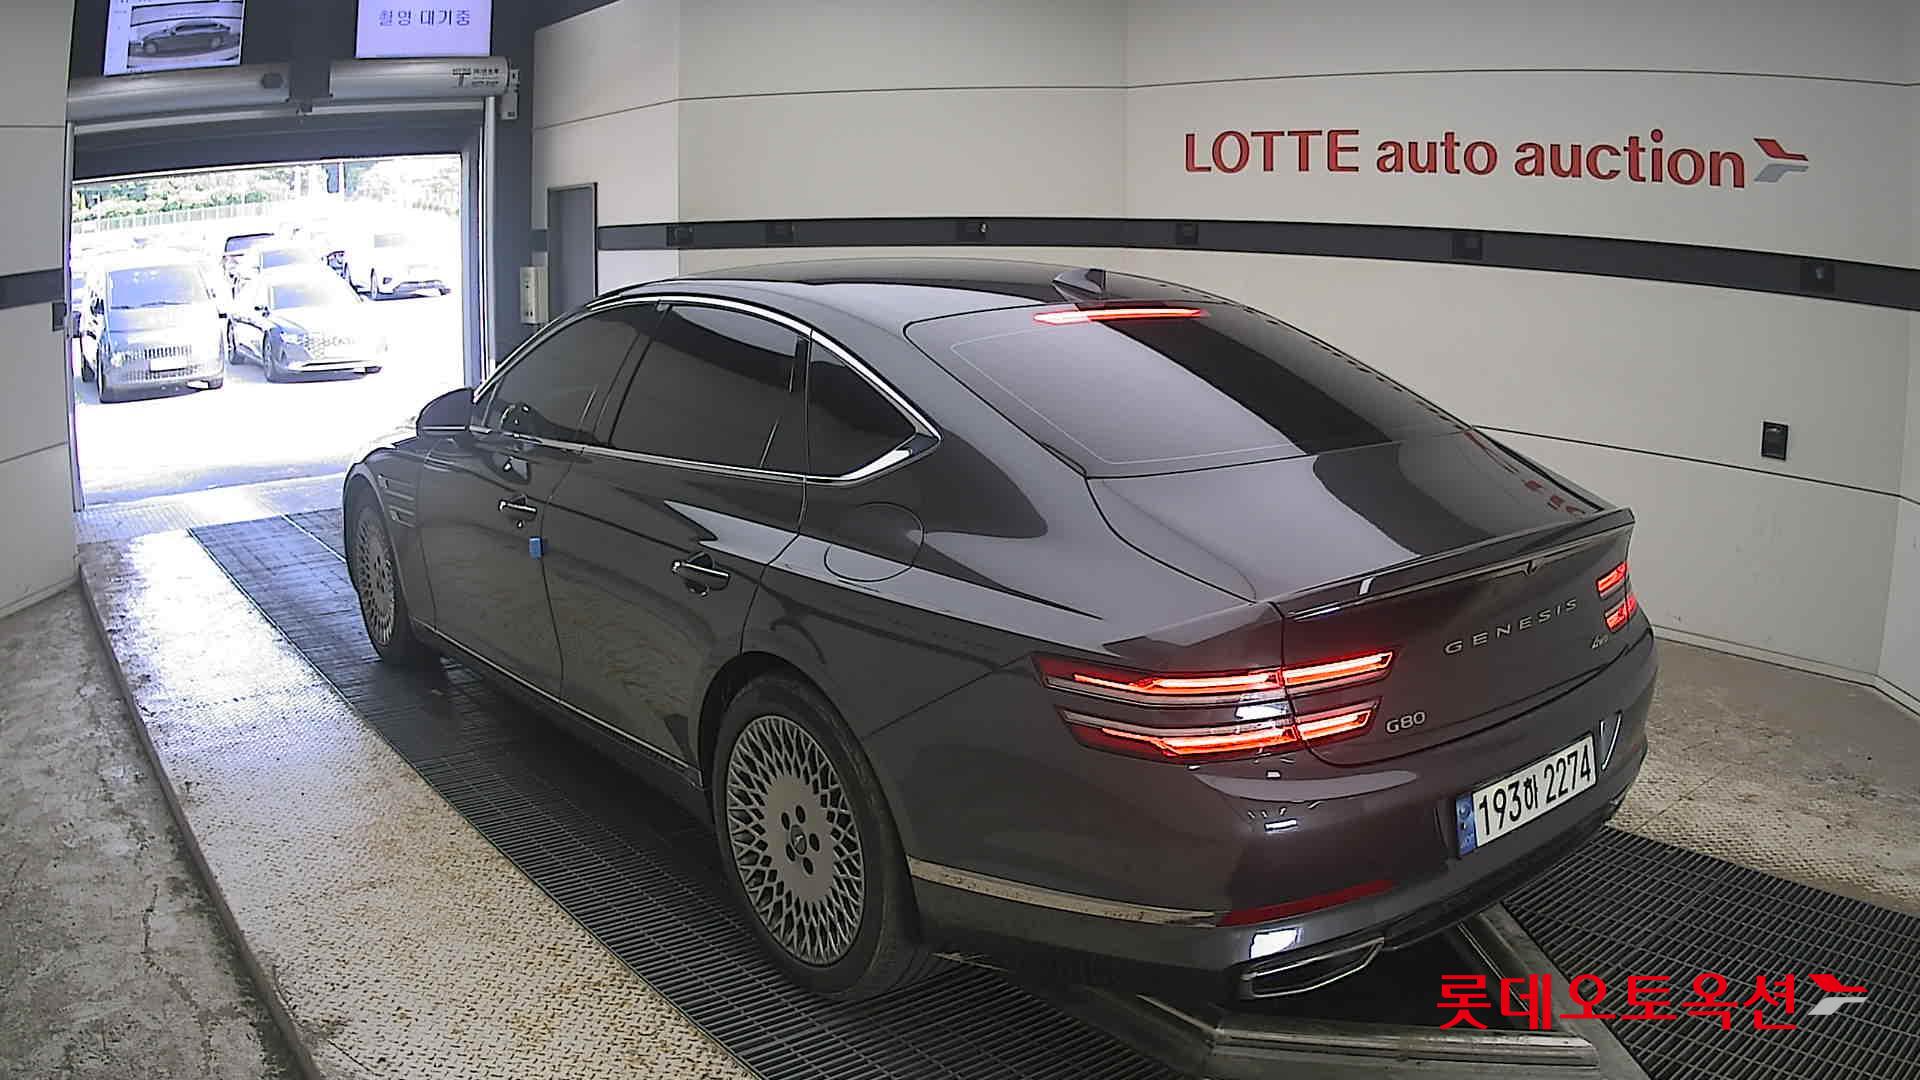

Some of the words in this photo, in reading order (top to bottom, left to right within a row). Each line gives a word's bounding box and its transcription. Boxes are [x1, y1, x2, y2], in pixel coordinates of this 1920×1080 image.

[420, 9, 471, 26] 대기중
[1185, 129, 1361, 174] LOTTE
[1375, 131, 1498, 176] auto
[1514, 129, 1746, 189] auction
[1444, 599, 1578, 655] GENESIS
[1385, 710, 1426, 733] G80
[1479, 774, 1539, 836] 193하
[1543, 744, 1592, 805] 2274
